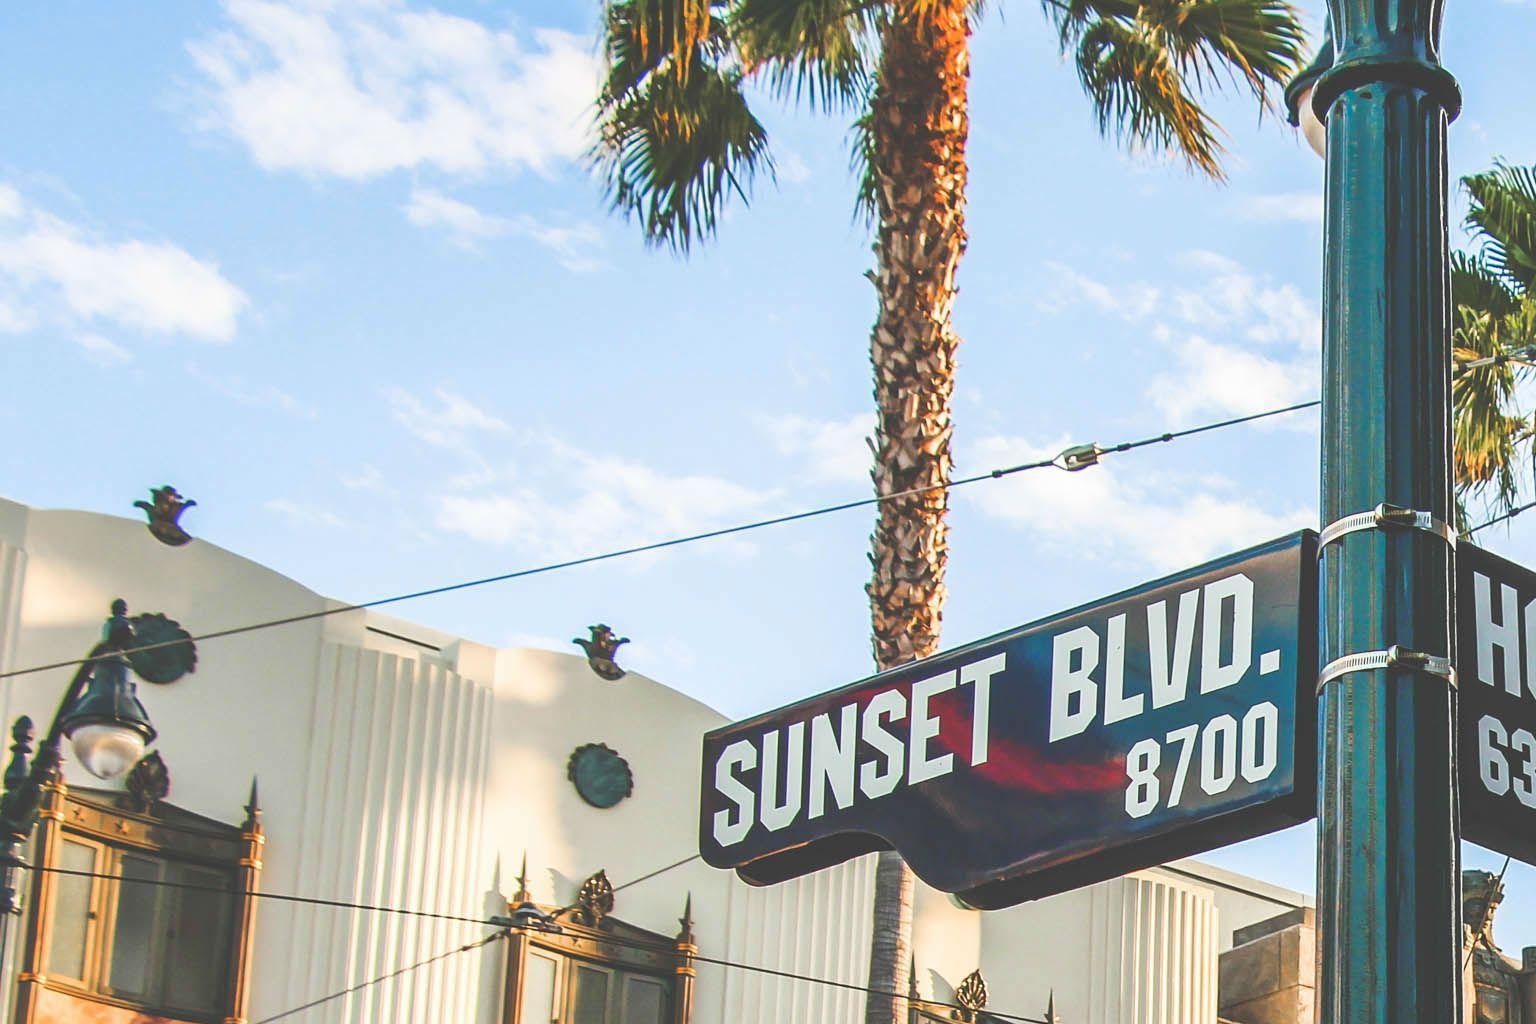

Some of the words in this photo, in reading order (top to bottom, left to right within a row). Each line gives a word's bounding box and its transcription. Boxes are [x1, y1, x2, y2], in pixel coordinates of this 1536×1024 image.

[713, 652, 1006, 847] SUNSET
[1049, 572, 1281, 743] BLVD.
[1125, 701, 1279, 819] 8700
